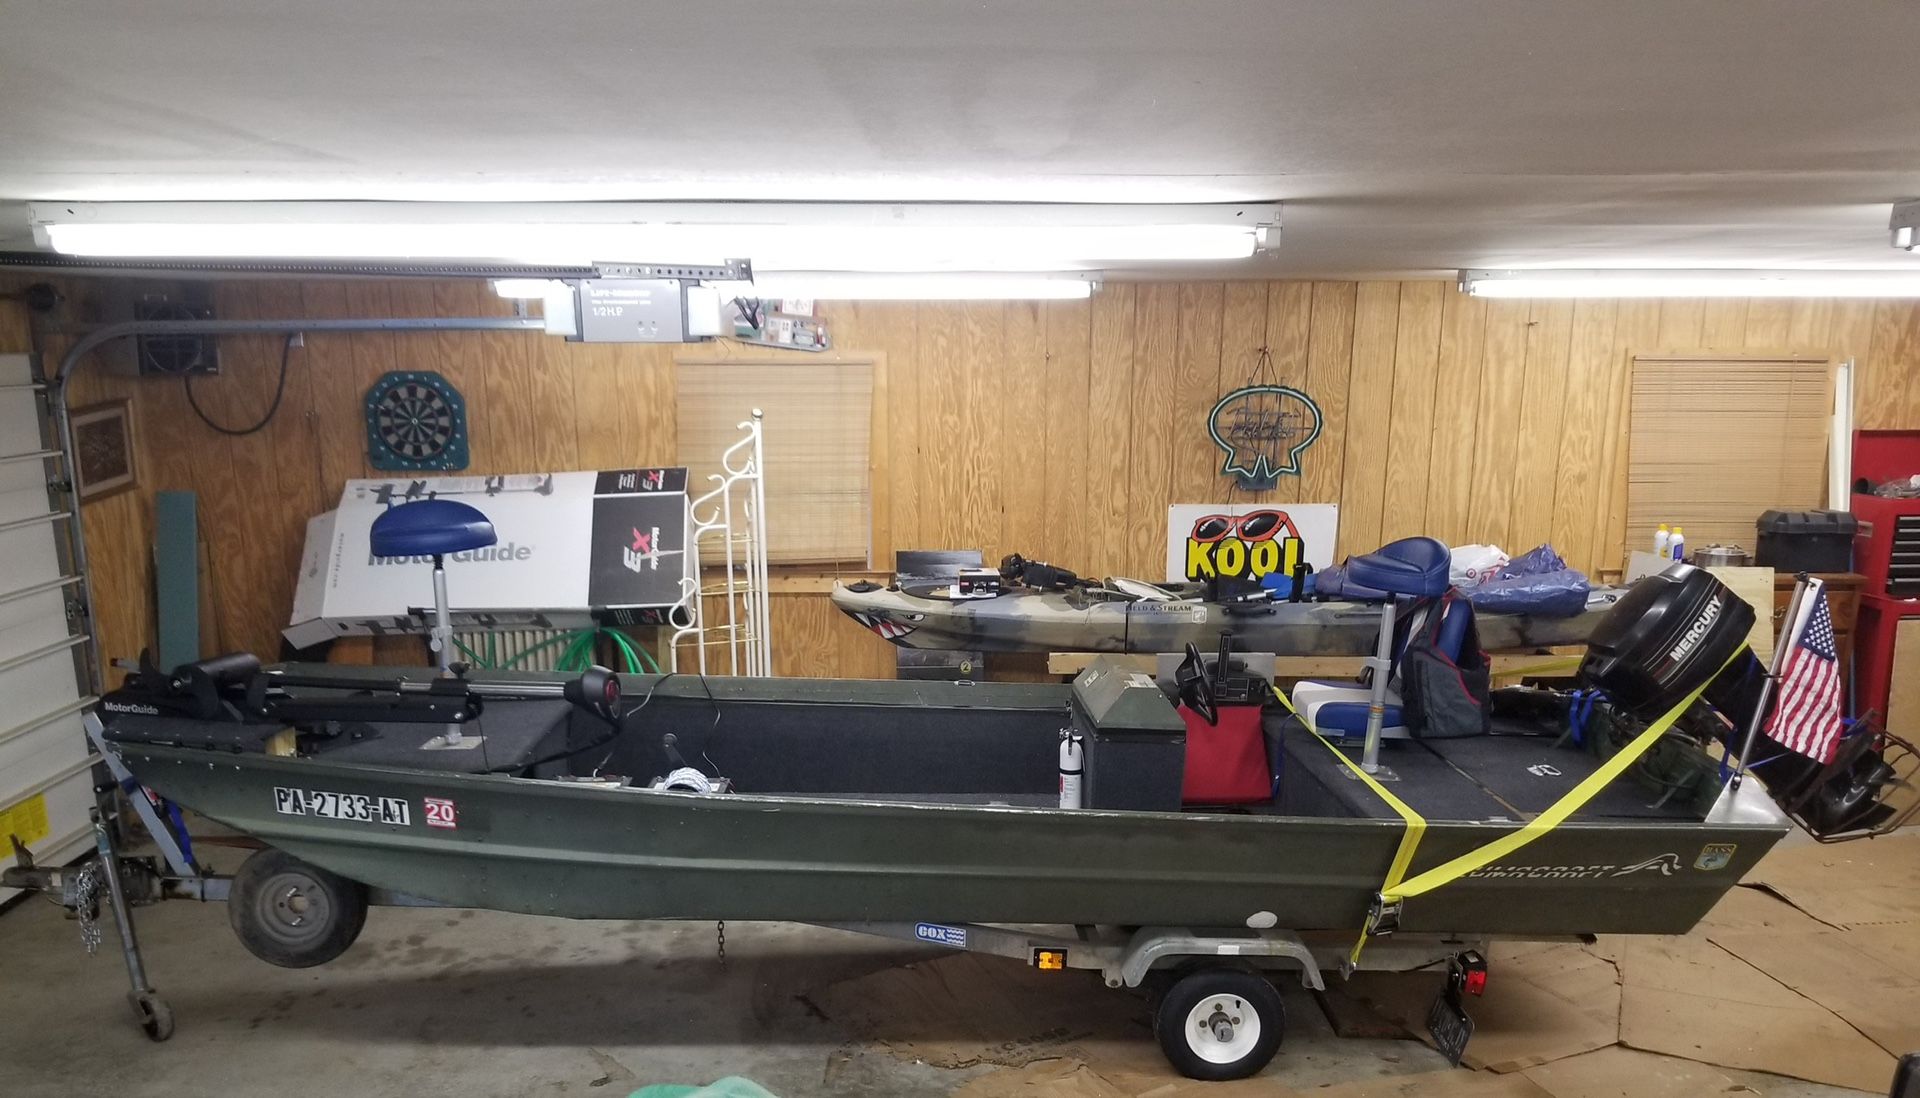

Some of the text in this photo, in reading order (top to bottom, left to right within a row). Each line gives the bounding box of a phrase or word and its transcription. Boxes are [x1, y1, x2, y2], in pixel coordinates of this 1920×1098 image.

[368, 542, 531, 566] MotoGuide
[1669, 594, 1721, 661] MERCURY
[105, 702, 159, 714] MotorGuide
[274, 788, 408, 824] PA-2733-AT
[426, 803, 454, 821] 20
[918, 925, 946, 940] COX
